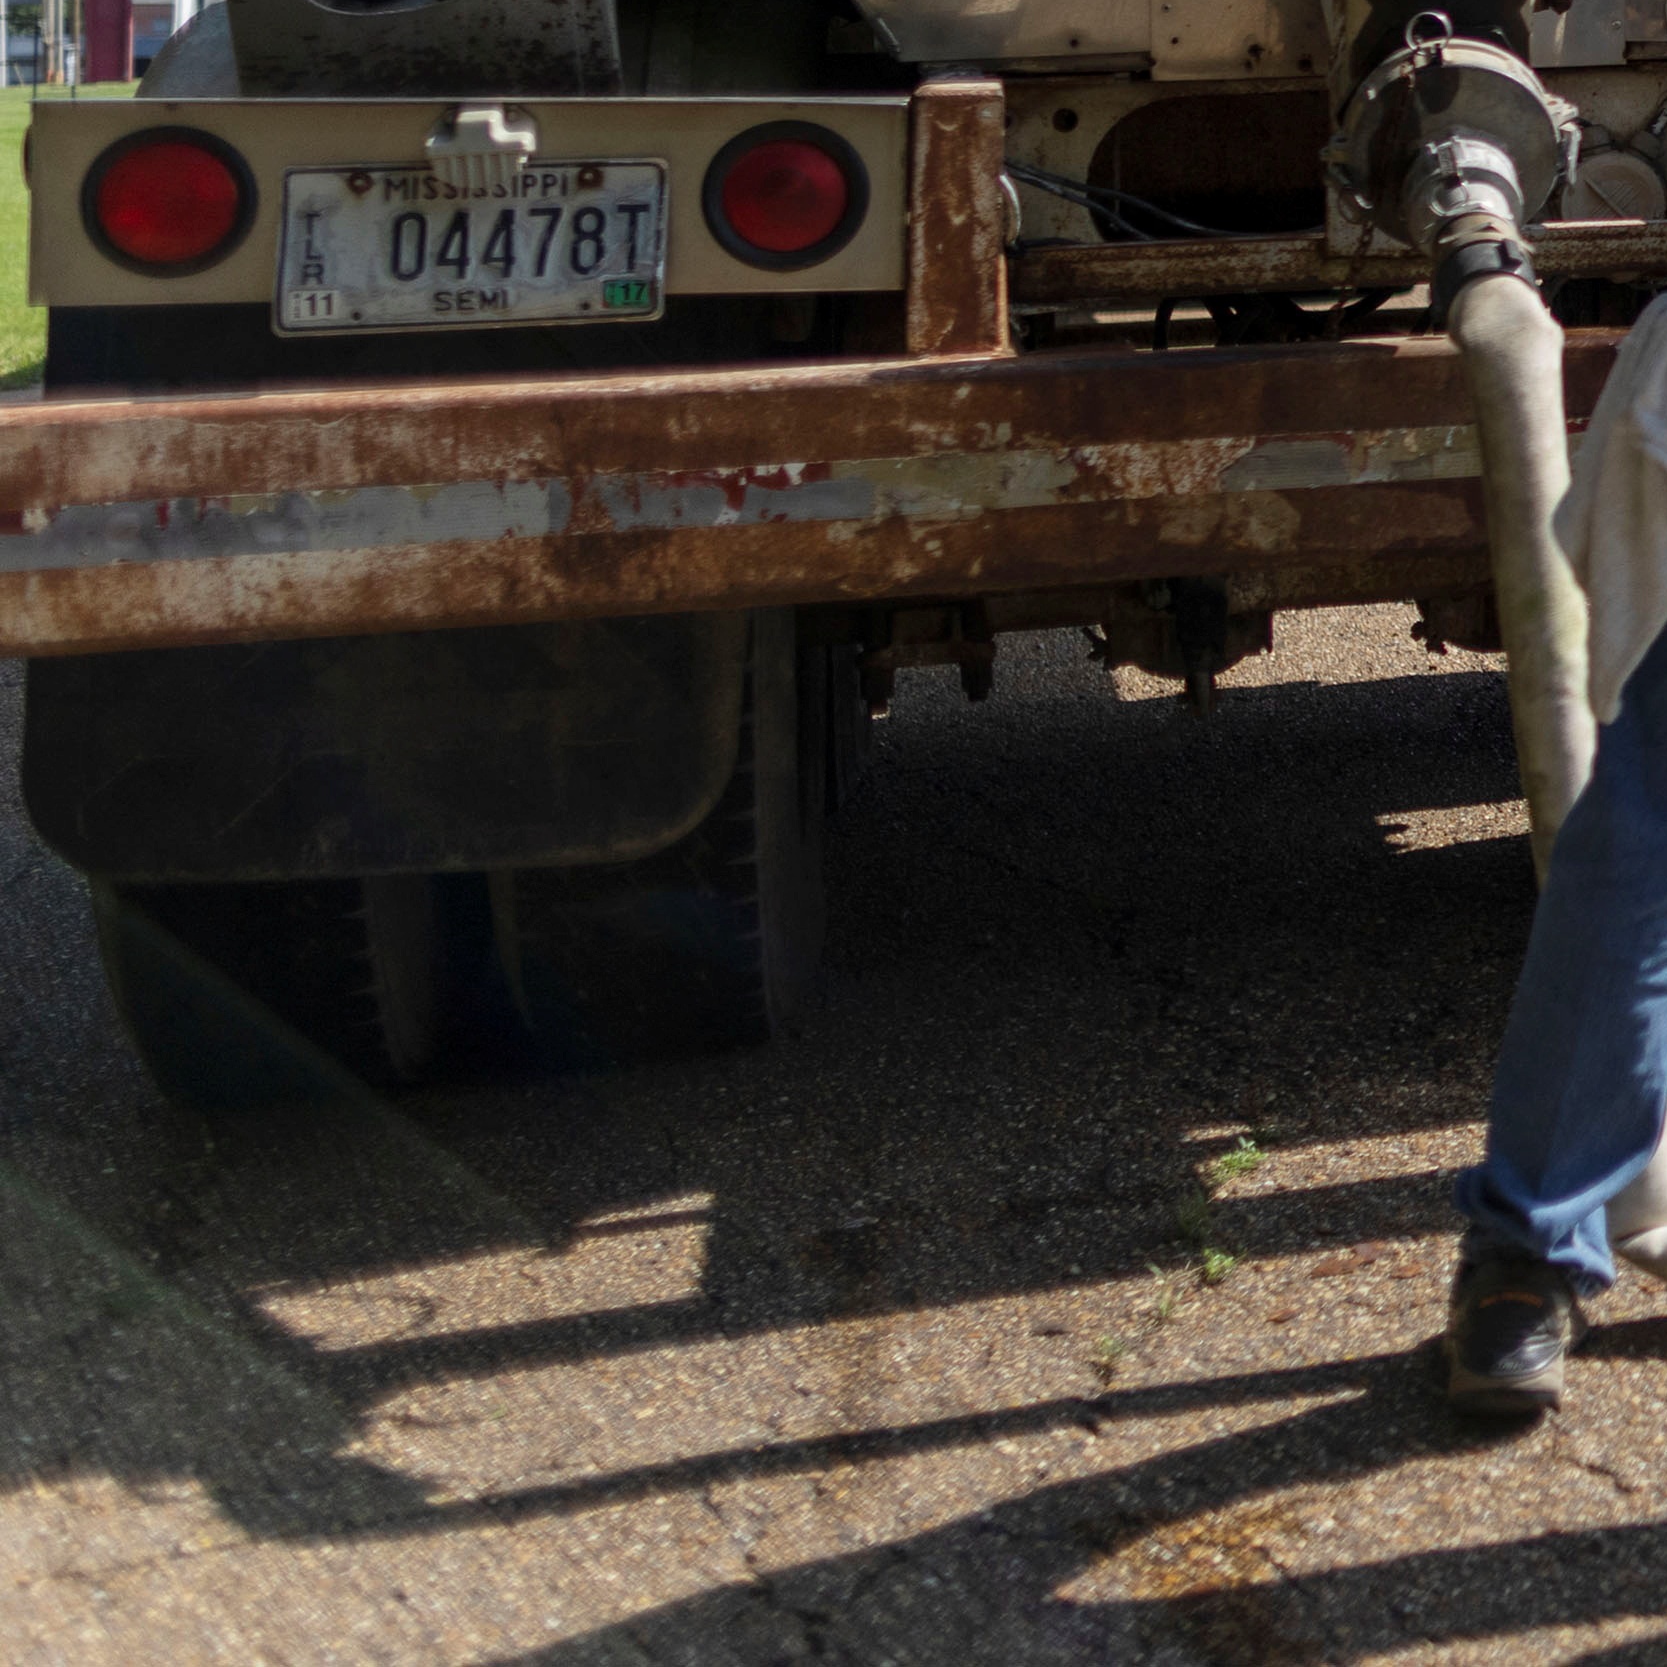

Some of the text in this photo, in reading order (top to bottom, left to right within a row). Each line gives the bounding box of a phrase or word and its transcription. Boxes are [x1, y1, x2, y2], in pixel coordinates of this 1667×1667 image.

[391, 203, 650, 282] 04478T
[433, 289, 510, 313] SEMI
[619, 283, 647, 300] 17
[305, 293, 333, 316] 11
